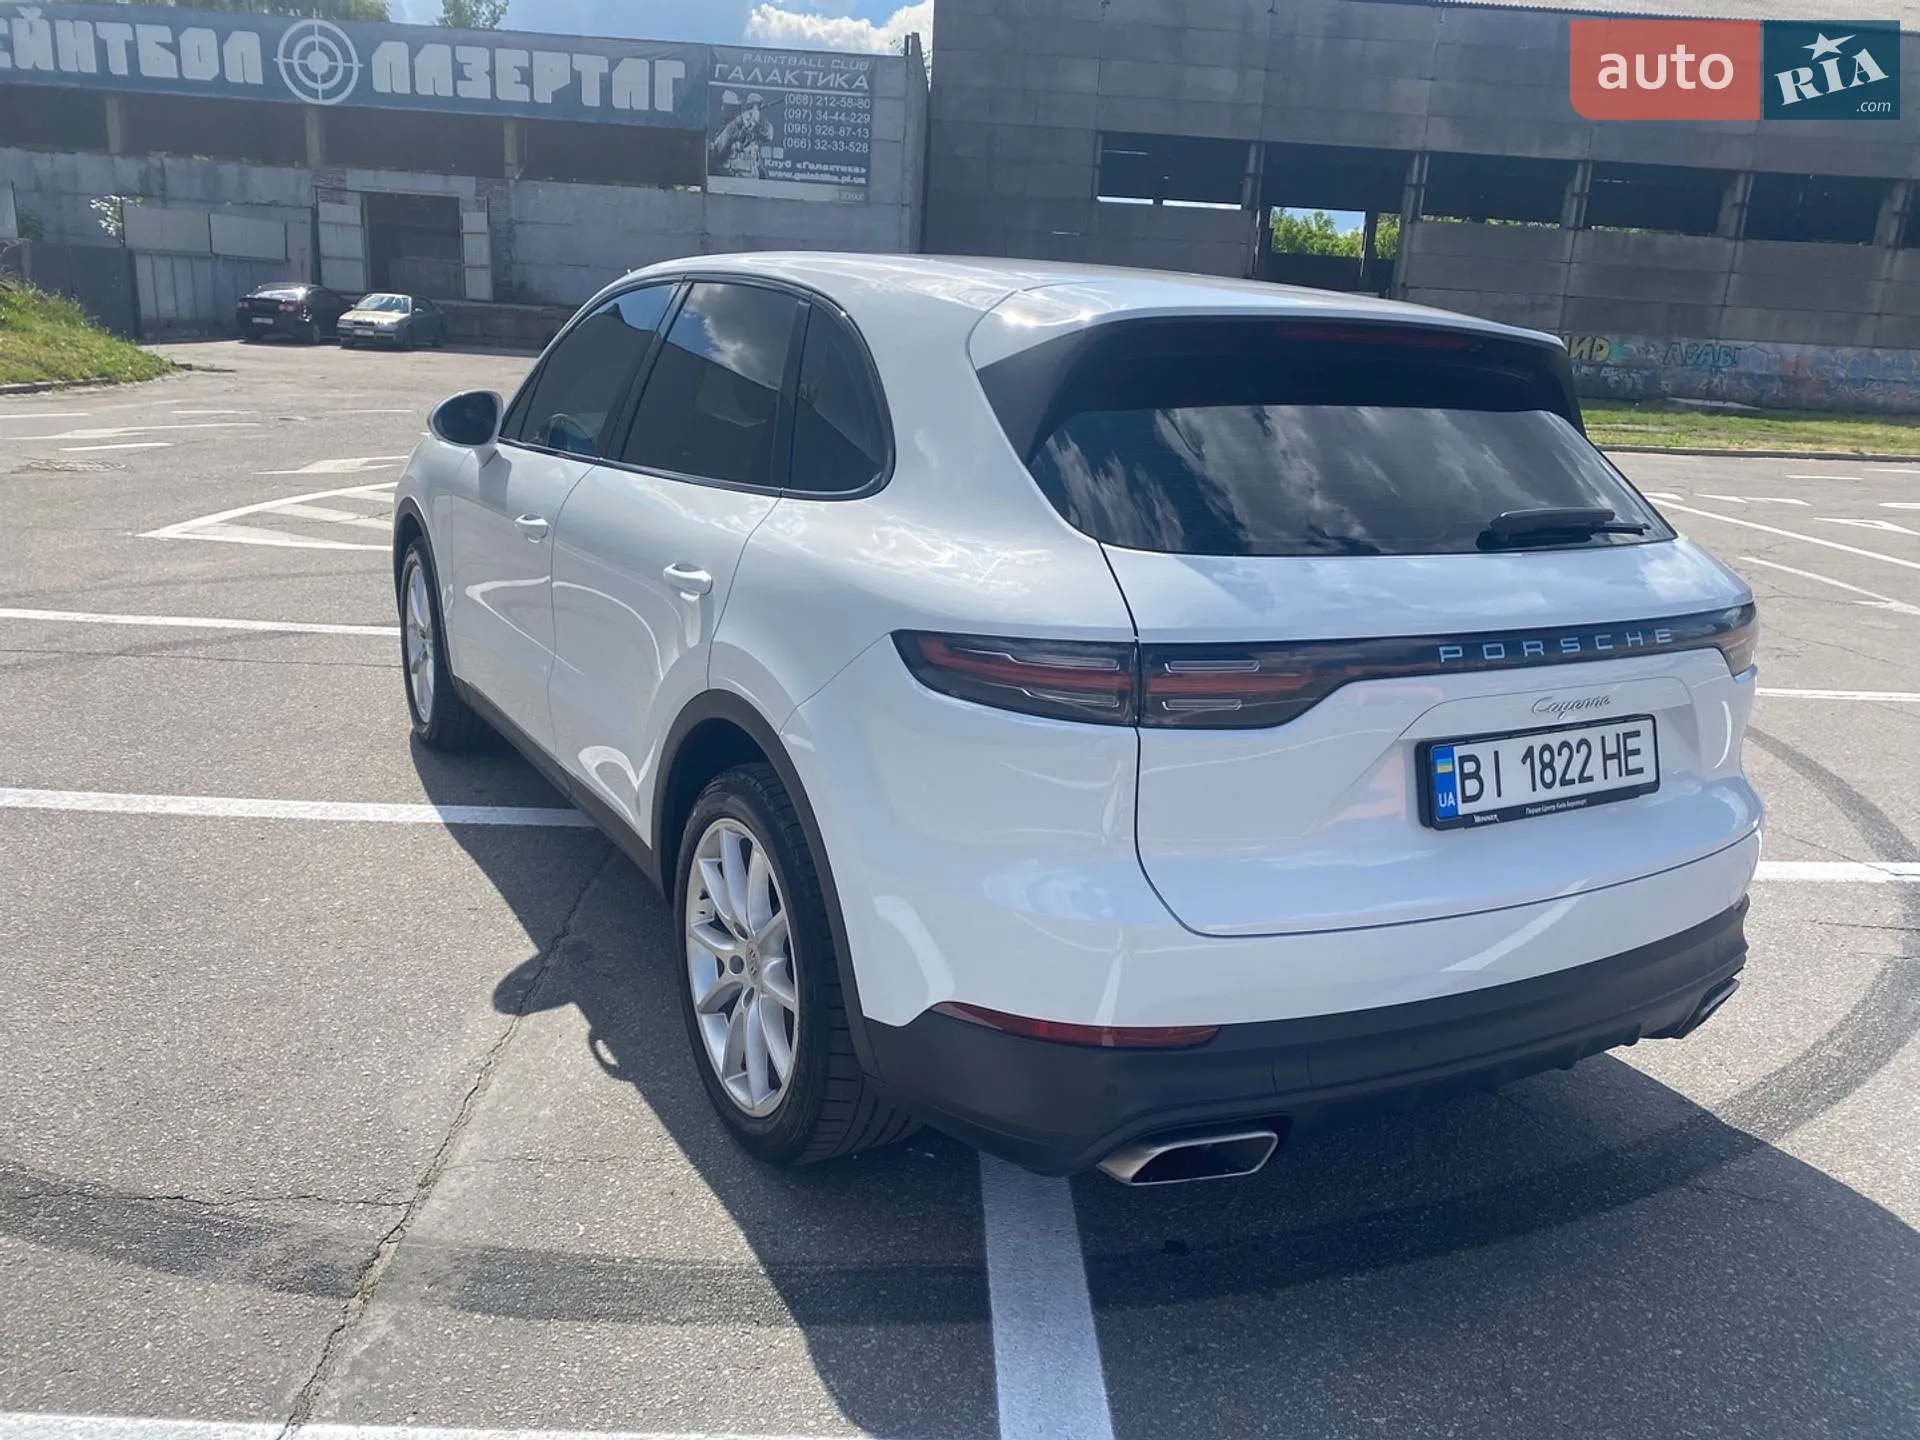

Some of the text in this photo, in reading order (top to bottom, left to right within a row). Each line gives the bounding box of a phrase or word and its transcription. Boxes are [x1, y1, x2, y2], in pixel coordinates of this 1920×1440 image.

[742, 52, 869, 71] PAINTBALL CLUB
[371, 41, 686, 112] ЛАЗЕРТАГ
[714, 63, 869, 90] ГАЛАКТИКА
[764, 158, 792, 169] Клуб
[1439, 628, 1673, 663] PORSCHE
[1531, 694, 1611, 720] Cayenne
[1458, 730, 1645, 804] BI 1822 HE
[1438, 792, 1456, 808] UA
